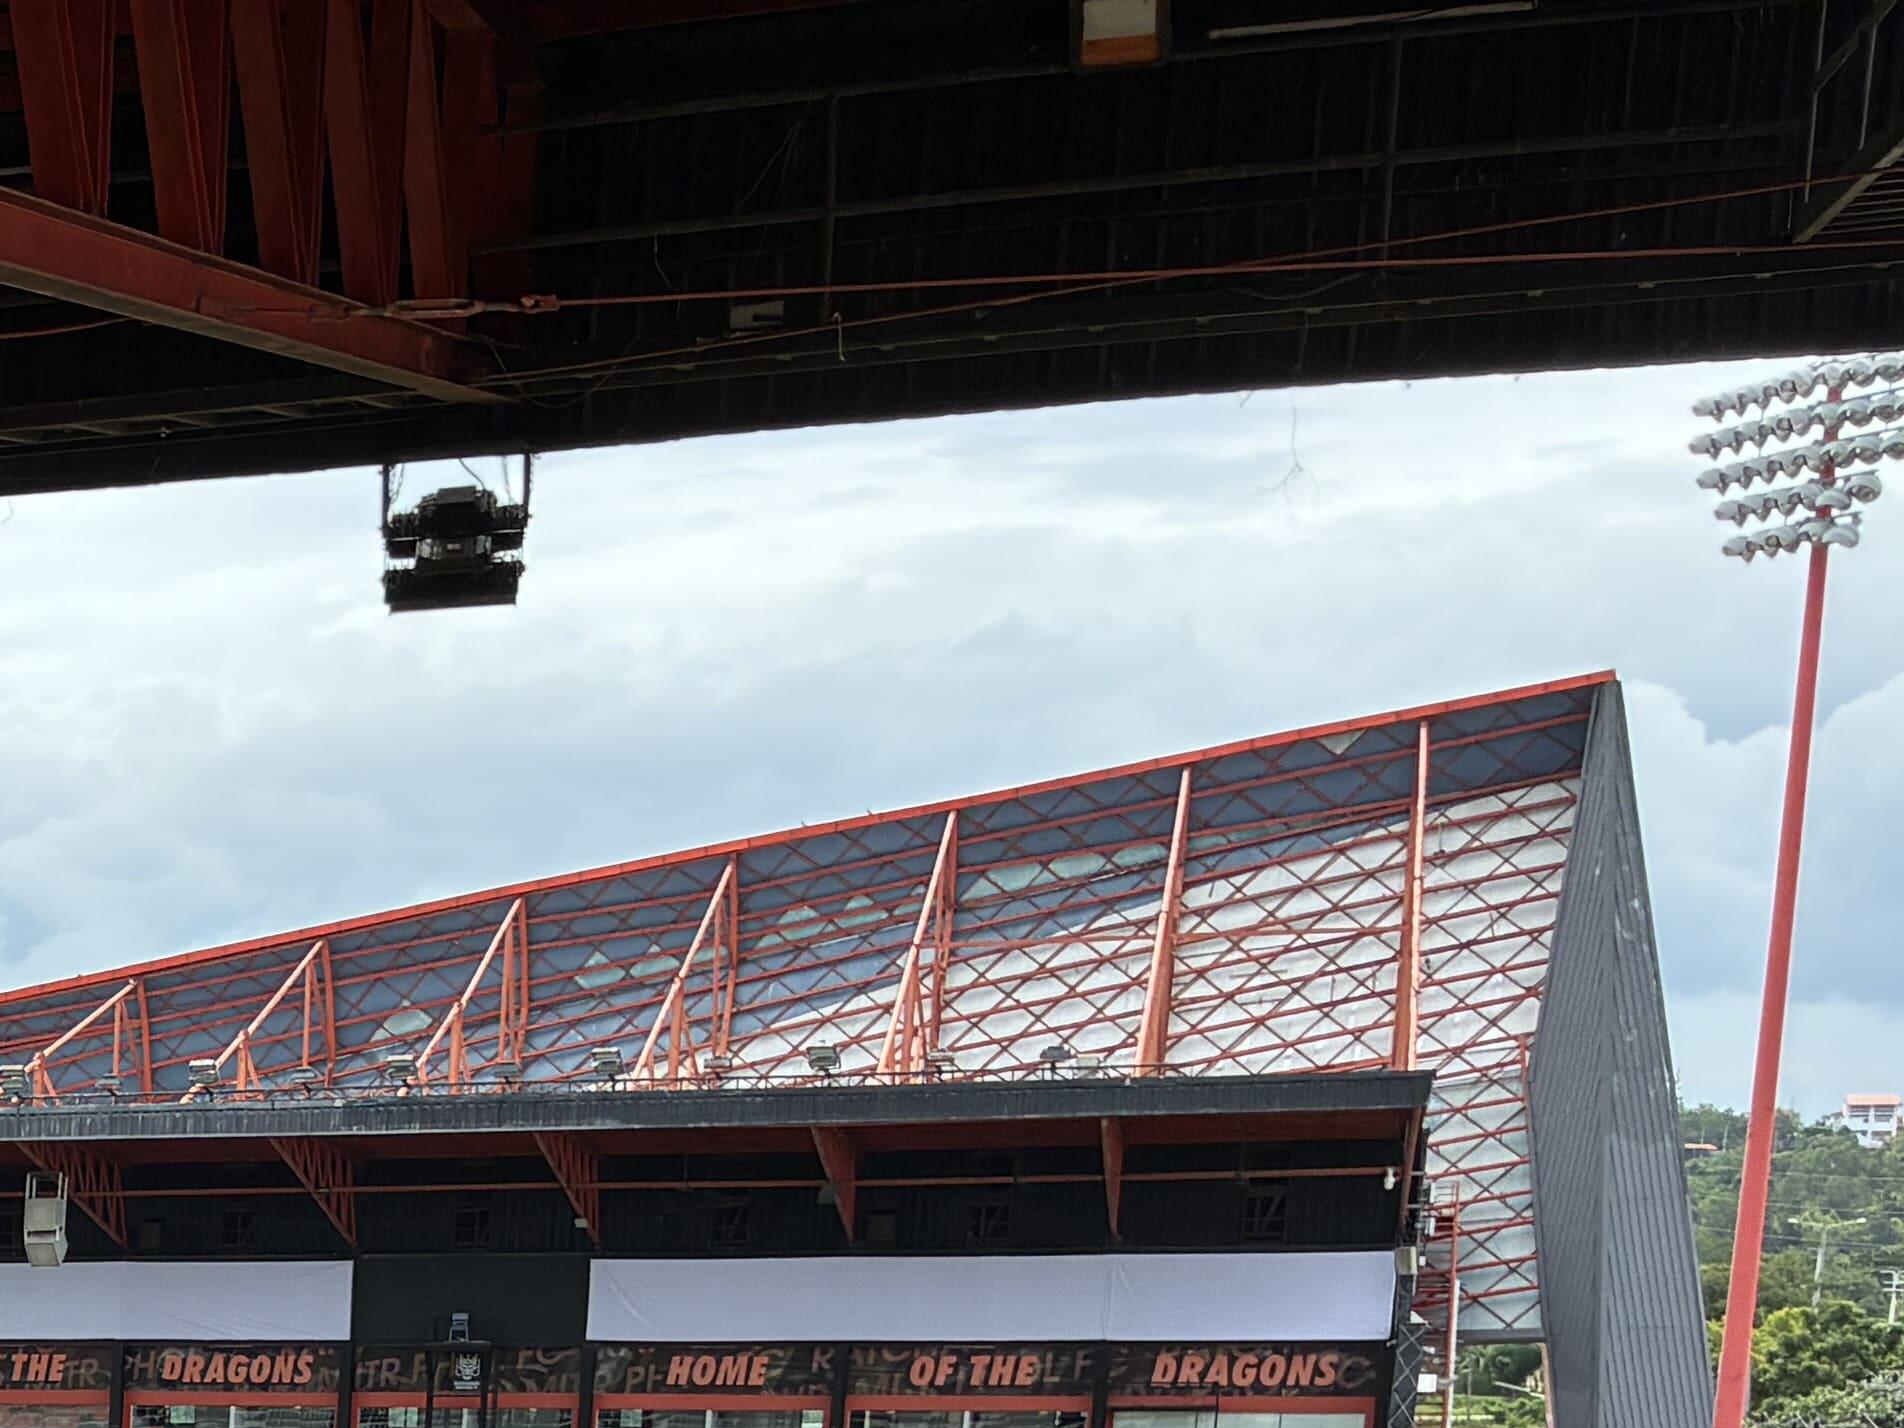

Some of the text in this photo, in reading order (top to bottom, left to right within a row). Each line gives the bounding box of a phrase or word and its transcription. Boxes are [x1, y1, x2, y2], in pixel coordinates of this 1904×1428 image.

[11, 1353, 68, 1384] THE
[161, 1354, 313, 1385] DRAGONS
[664, 1355, 769, 1387] HOME
[909, 1355, 956, 1387] OF
[968, 1355, 1036, 1387] THE
[1151, 1354, 1338, 1388] DRAGONS
